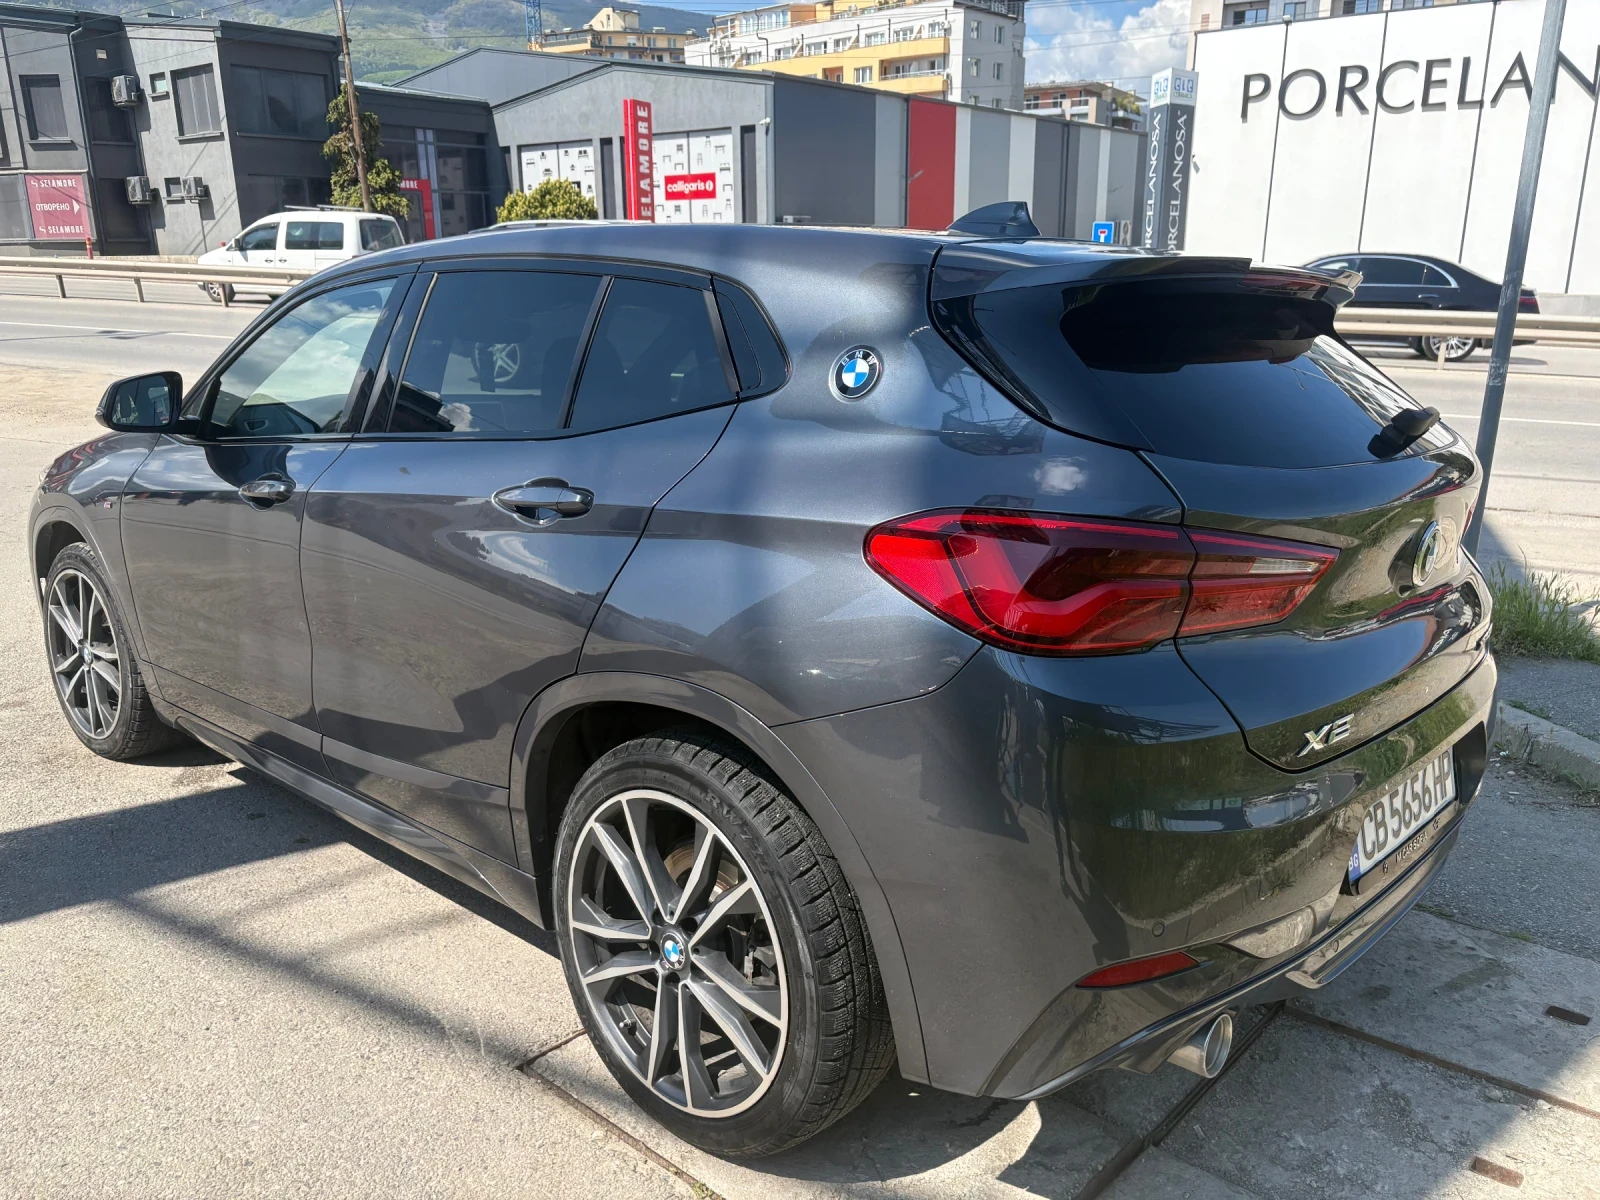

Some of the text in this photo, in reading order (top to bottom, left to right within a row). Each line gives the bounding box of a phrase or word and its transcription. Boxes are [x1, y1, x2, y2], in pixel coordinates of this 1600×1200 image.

[1241, 45, 1600, 124] PORCELAN
[40, 179, 77, 188] SELAMORE
[667, 179, 705, 194] calligaris
[35, 203, 70, 211] ОТВОРЕНО
[47, 225, 84, 234] SELAMORE
[841, 350, 877, 366] BMW
